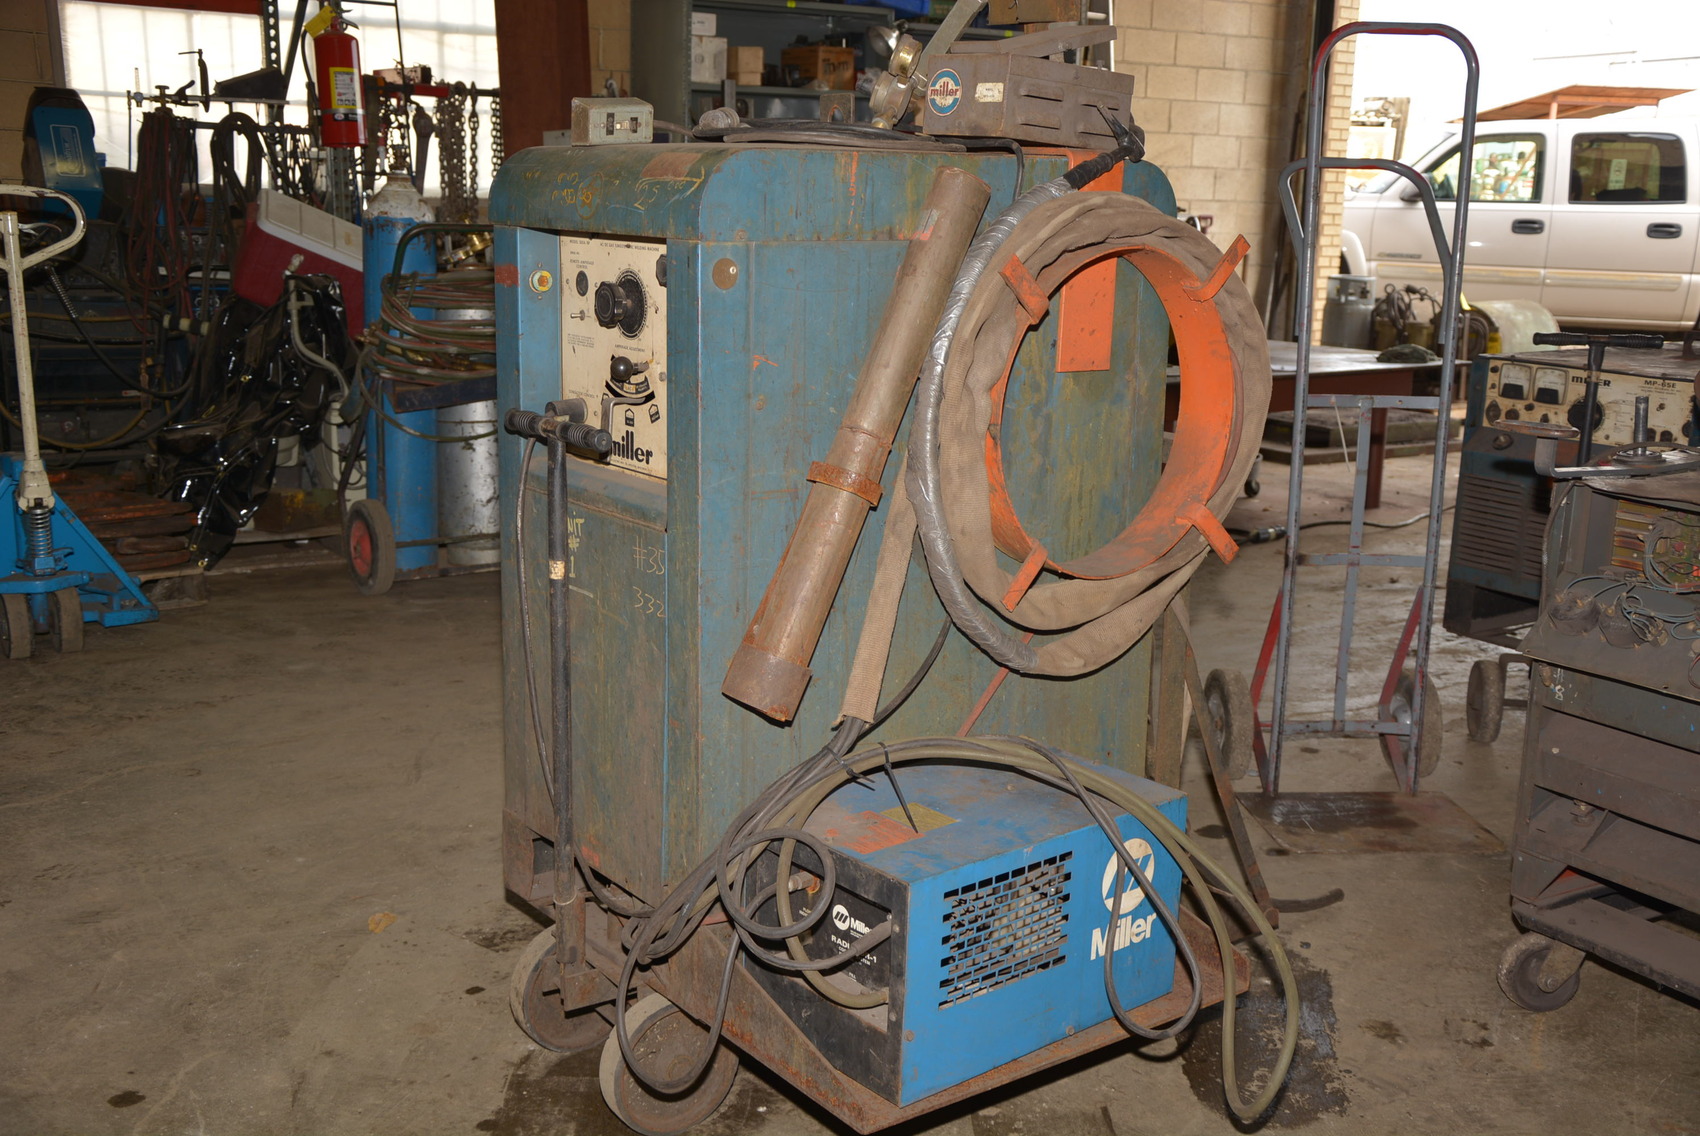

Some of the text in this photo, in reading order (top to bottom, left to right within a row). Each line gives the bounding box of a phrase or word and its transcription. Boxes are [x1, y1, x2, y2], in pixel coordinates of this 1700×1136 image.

[930, 81, 960, 98] miller
[632, 586, 667, 617] 332
[850, 916, 873, 935] Mille
[1090, 912, 1158, 961] Miller
